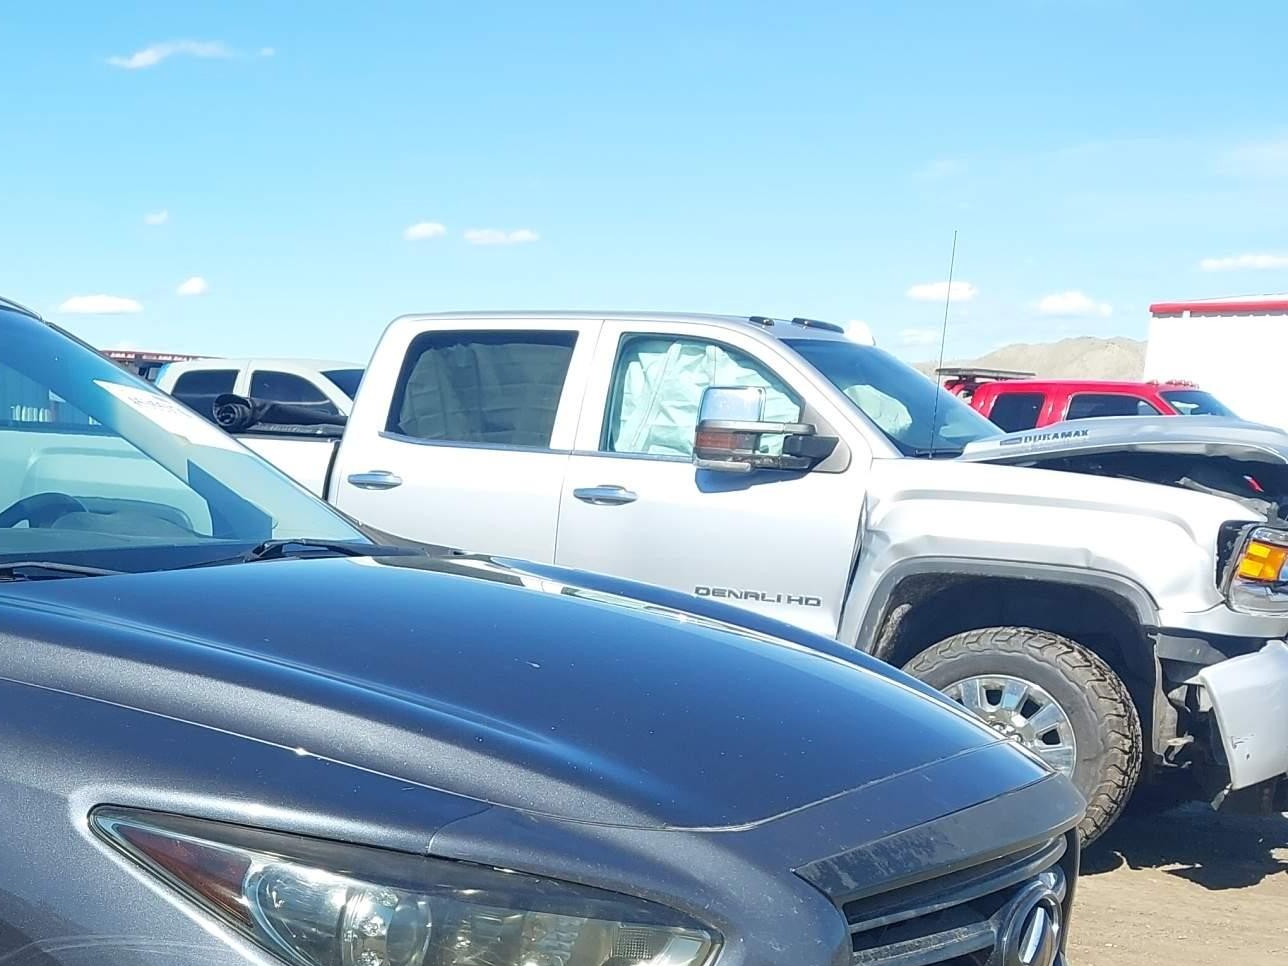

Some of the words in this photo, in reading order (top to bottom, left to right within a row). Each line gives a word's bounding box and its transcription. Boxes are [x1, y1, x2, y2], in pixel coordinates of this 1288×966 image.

[1023, 428, 1089, 444] DURAMAX
[694, 586, 782, 604] DENALI
[786, 595, 822, 608] HD
